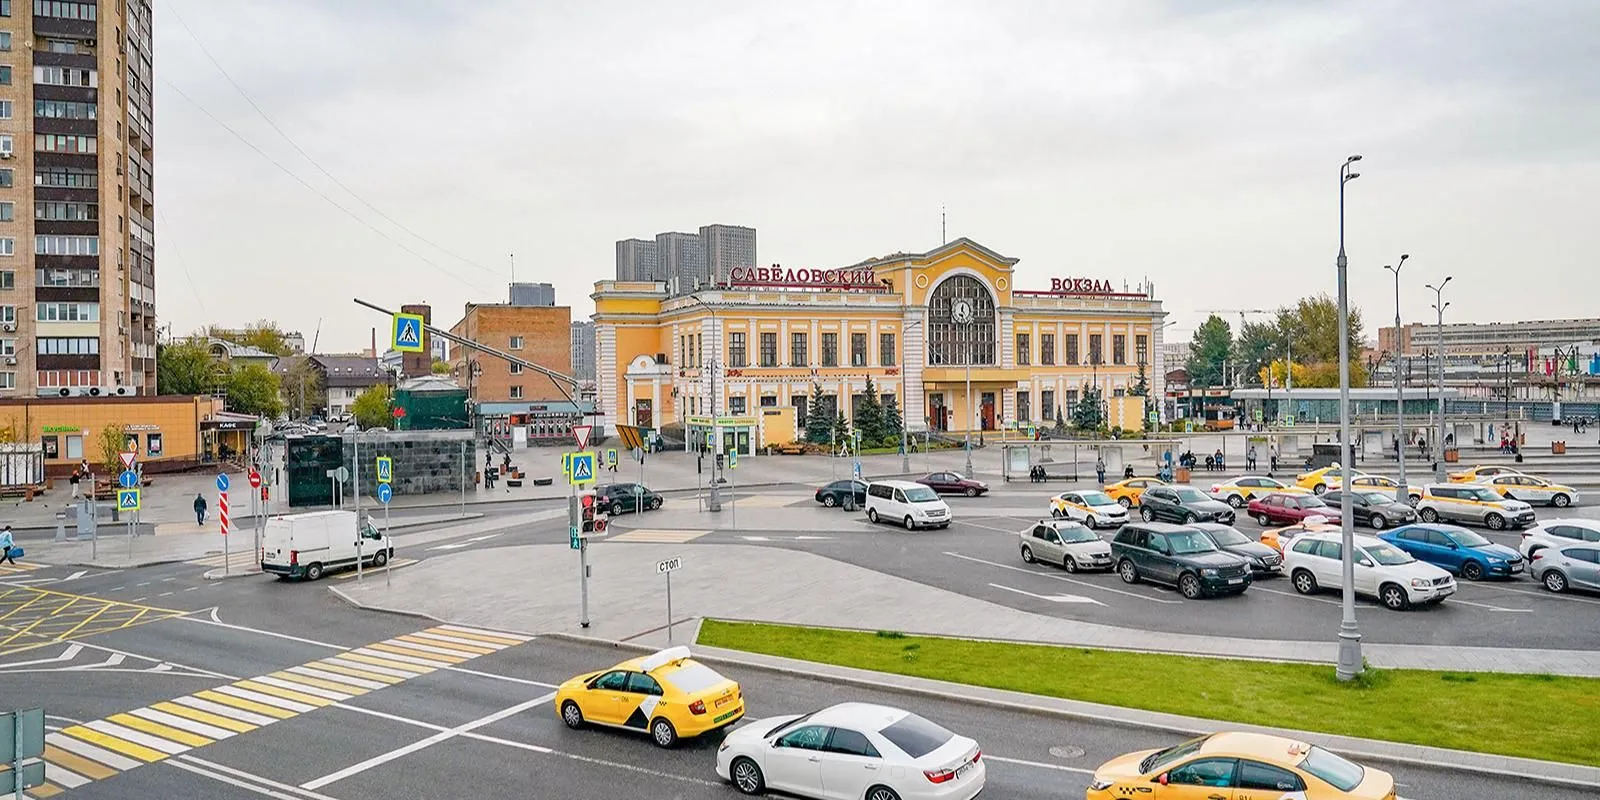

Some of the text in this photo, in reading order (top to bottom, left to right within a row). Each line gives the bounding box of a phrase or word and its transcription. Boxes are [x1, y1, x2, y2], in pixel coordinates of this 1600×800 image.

[731, 263, 876, 284] САВЁЛОВСКИЙ
[1050, 278, 1112, 292] ВОКЗАЛ
[659, 558, 679, 572] СТОП
